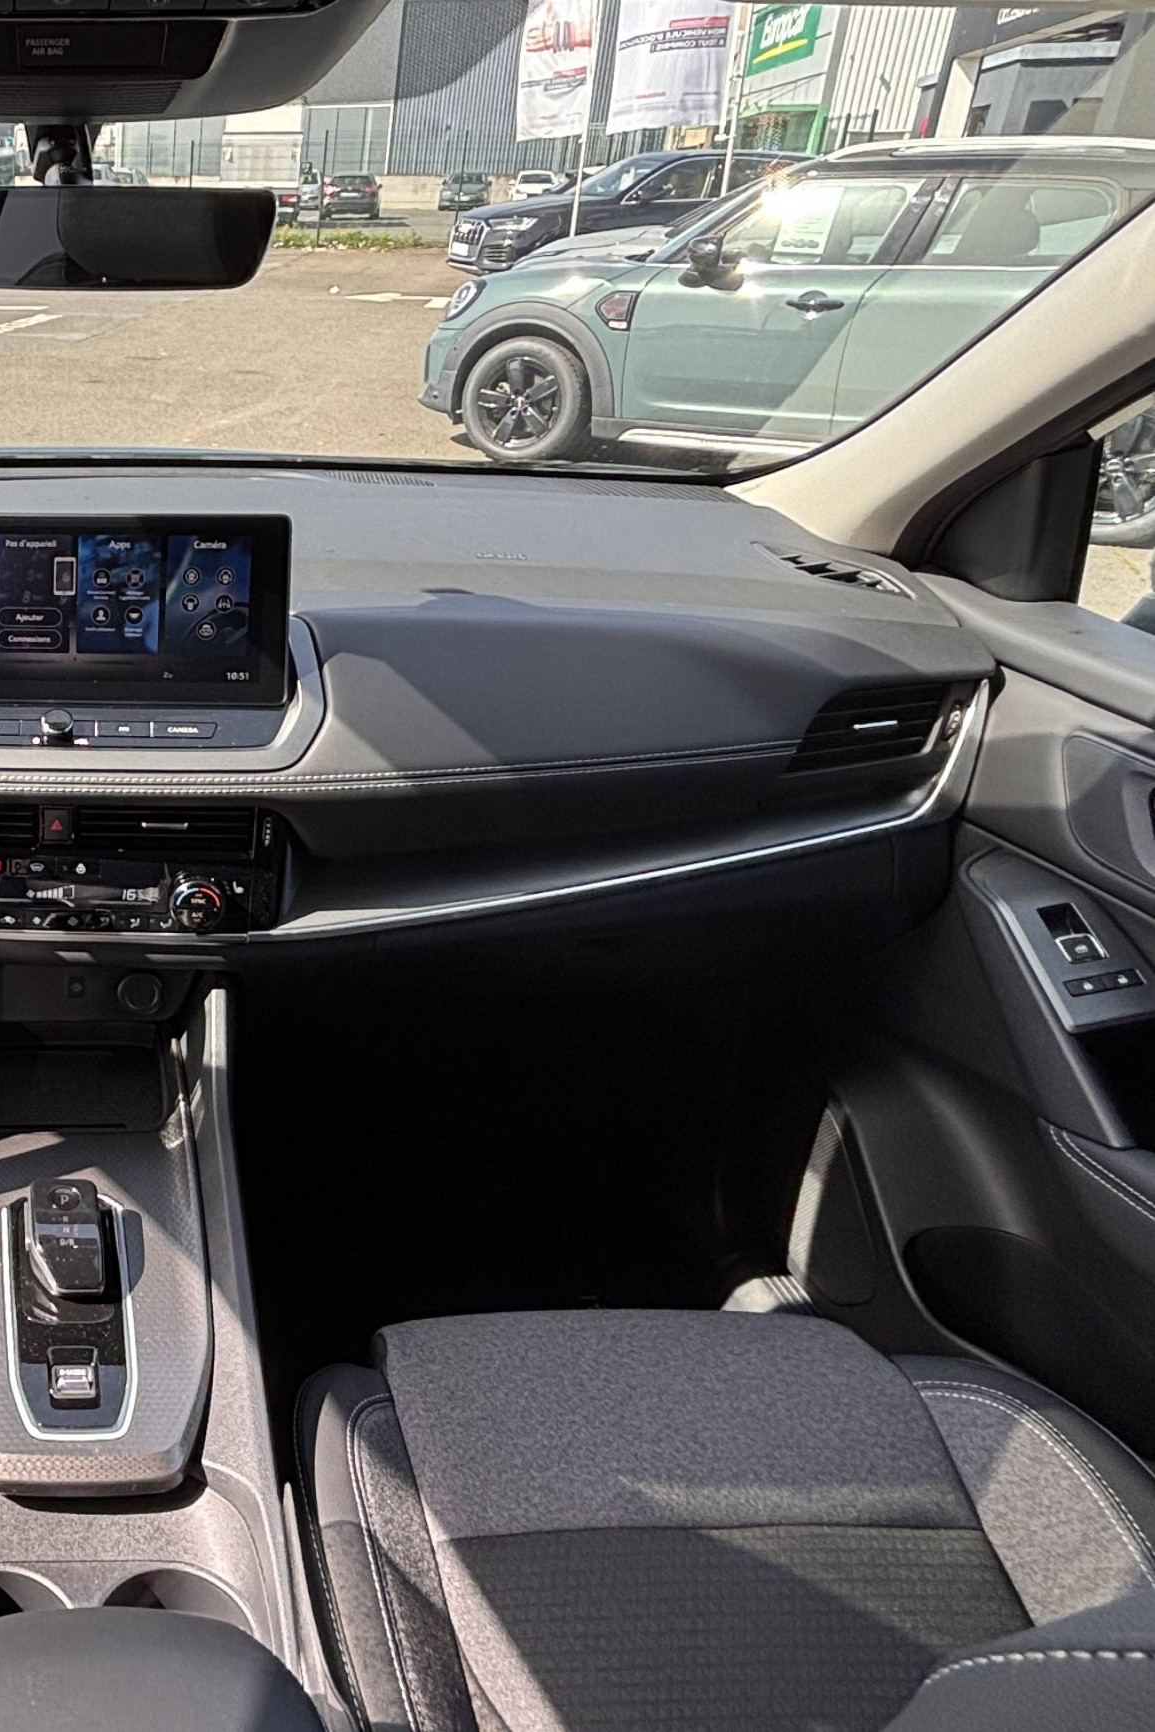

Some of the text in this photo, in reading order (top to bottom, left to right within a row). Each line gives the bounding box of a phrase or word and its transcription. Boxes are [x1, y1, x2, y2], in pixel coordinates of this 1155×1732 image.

[25, 38, 71, 47] PASSENGER
[31, 47, 64, 55] AIR BAG
[5, 539, 57, 550] Pas d'appareil
[109, 540, 131, 550] Apps
[193, 540, 227, 549] Caméra
[15, 612, 44, 622] Ajouter
[8, 634, 51, 643] Connexions
[226, 672, 250, 680] 10:51
[60, 1194, 69, 1205] P
